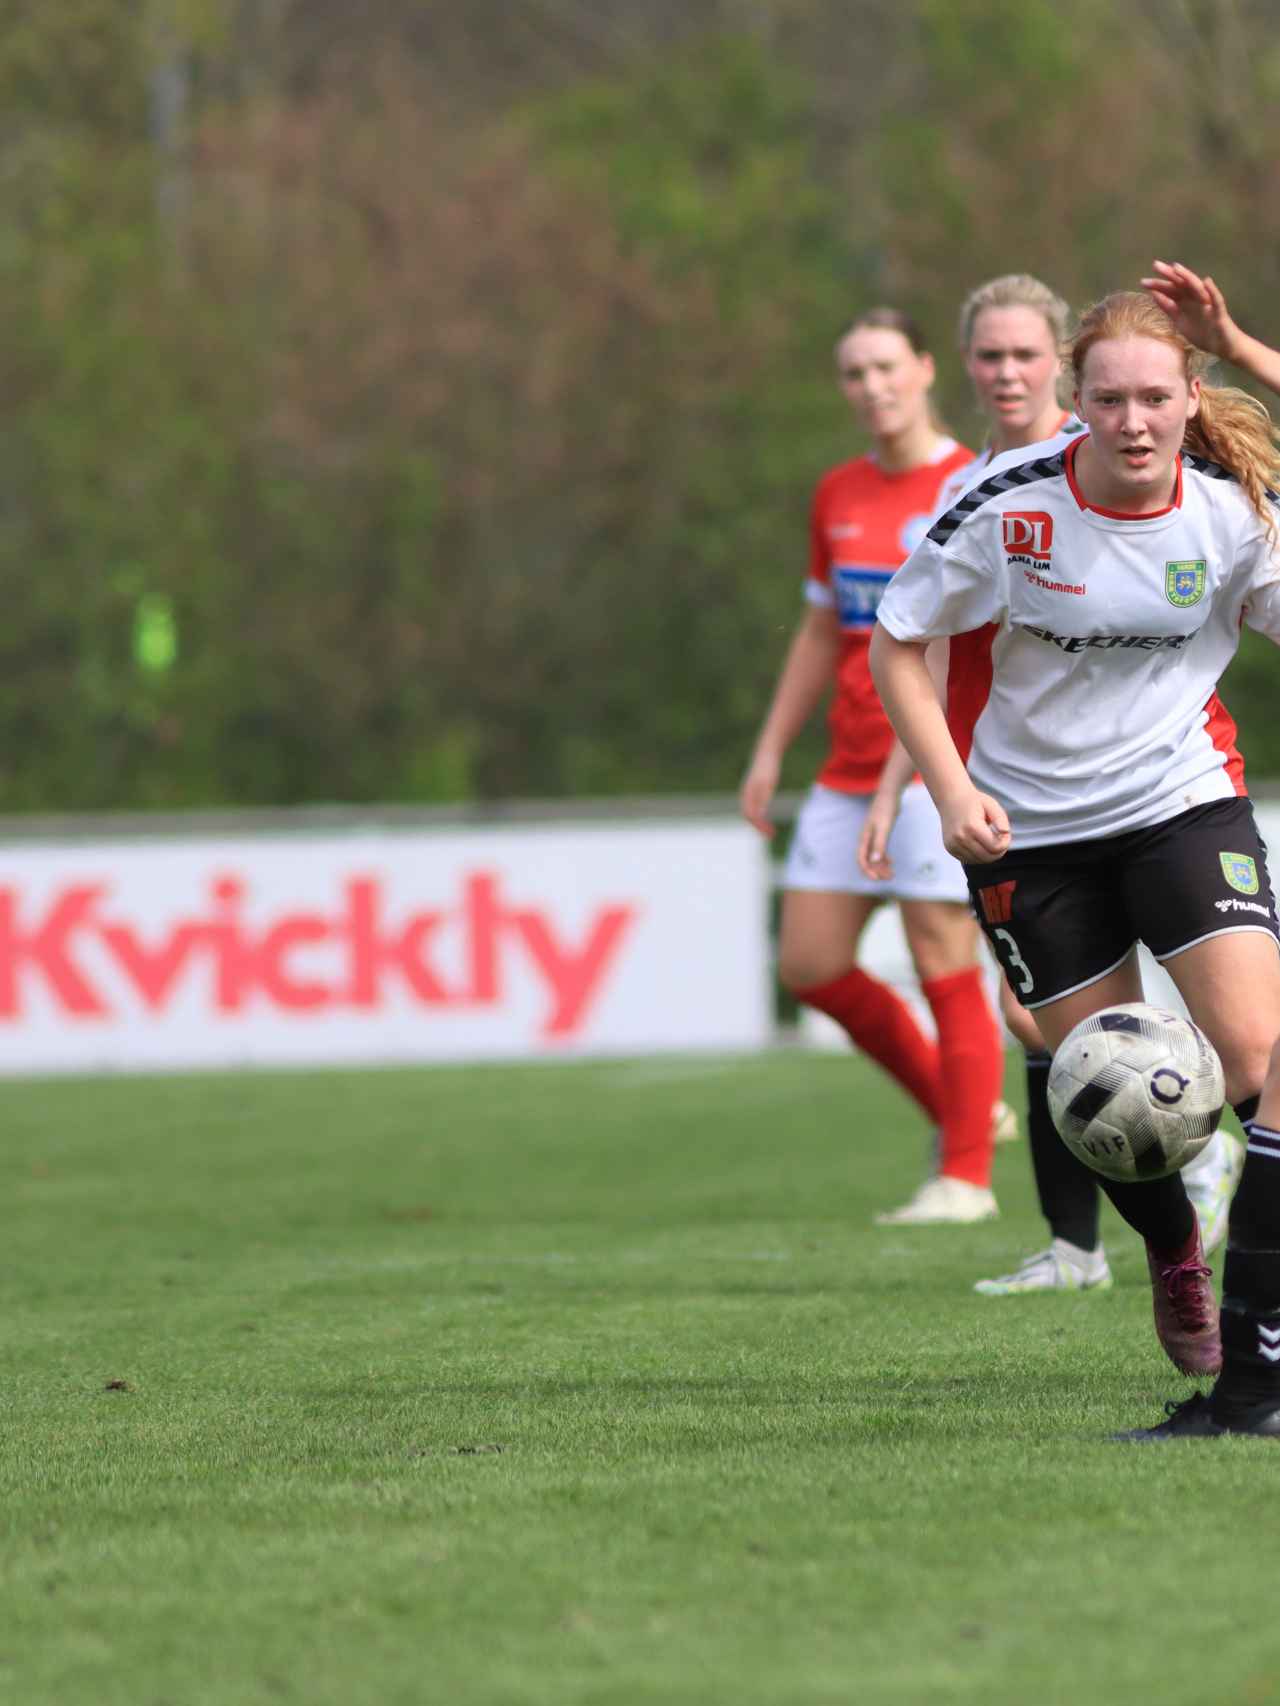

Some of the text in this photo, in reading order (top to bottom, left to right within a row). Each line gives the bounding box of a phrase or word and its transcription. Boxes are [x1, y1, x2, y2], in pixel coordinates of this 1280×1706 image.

[1033, 561, 1051, 571] LIM
[1036, 576, 1086, 596] hummel
[0, 870, 642, 1045] Kvickly
[994, 927, 1034, 994] 3
